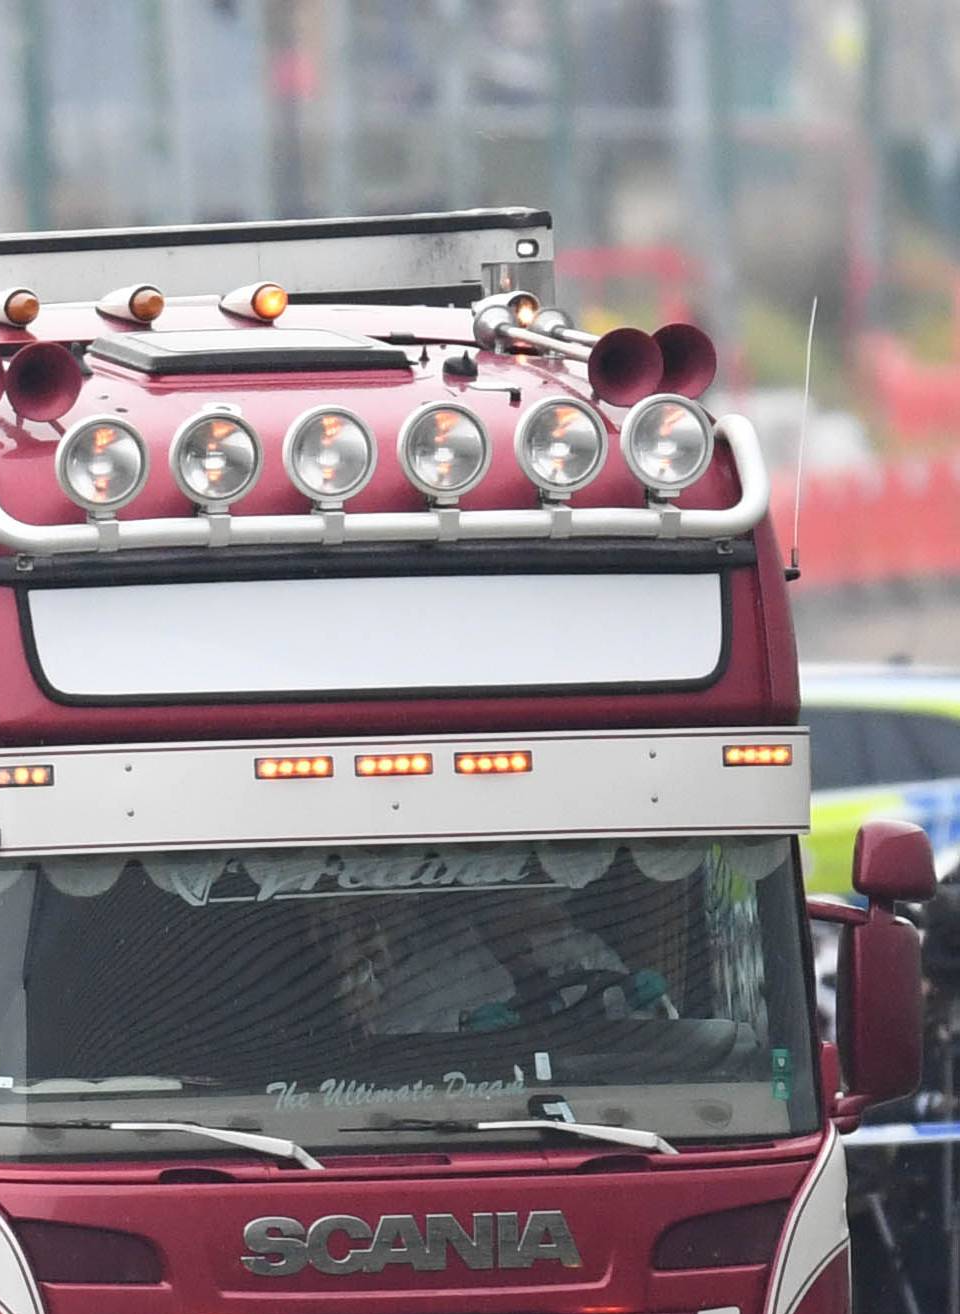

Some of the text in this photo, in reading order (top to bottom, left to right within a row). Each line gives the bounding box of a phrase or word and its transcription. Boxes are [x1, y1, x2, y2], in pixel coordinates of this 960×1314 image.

[266, 1081, 311, 1111] The
[320, 1078, 434, 1107] Ultimate
[240, 1210, 583, 1276] SCANIA
